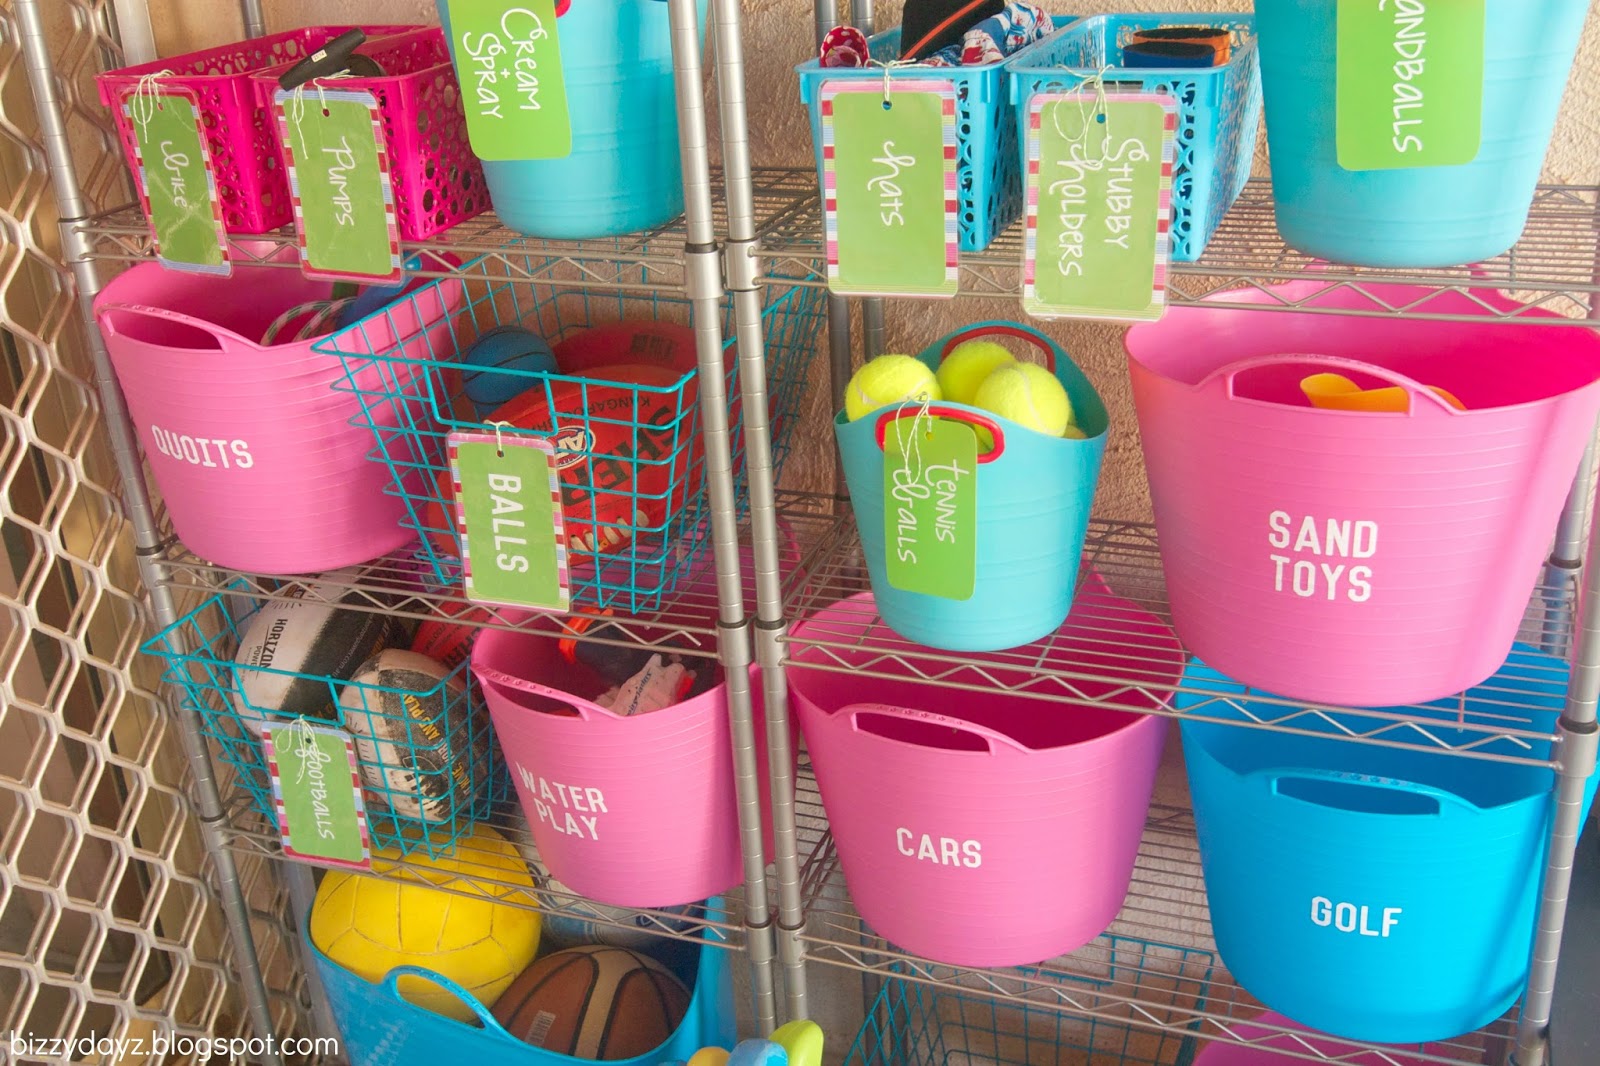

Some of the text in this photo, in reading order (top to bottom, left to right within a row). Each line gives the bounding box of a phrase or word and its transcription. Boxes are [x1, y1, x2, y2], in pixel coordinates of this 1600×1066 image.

[1379, 0, 1427, 153] ANDBALLS
[151, 424, 254, 469] QUOITS
[487, 472, 529, 574] BALLS
[1268, 510, 1378, 559] SAND
[1269, 553, 1373, 602] TOYS
[260, 617, 289, 669] HORIZON
[514, 760, 609, 813] WATER
[533, 797, 599, 841] PLAY
[896, 827, 982, 869] CARS
[1310, 895, 1403, 938] GOLF
